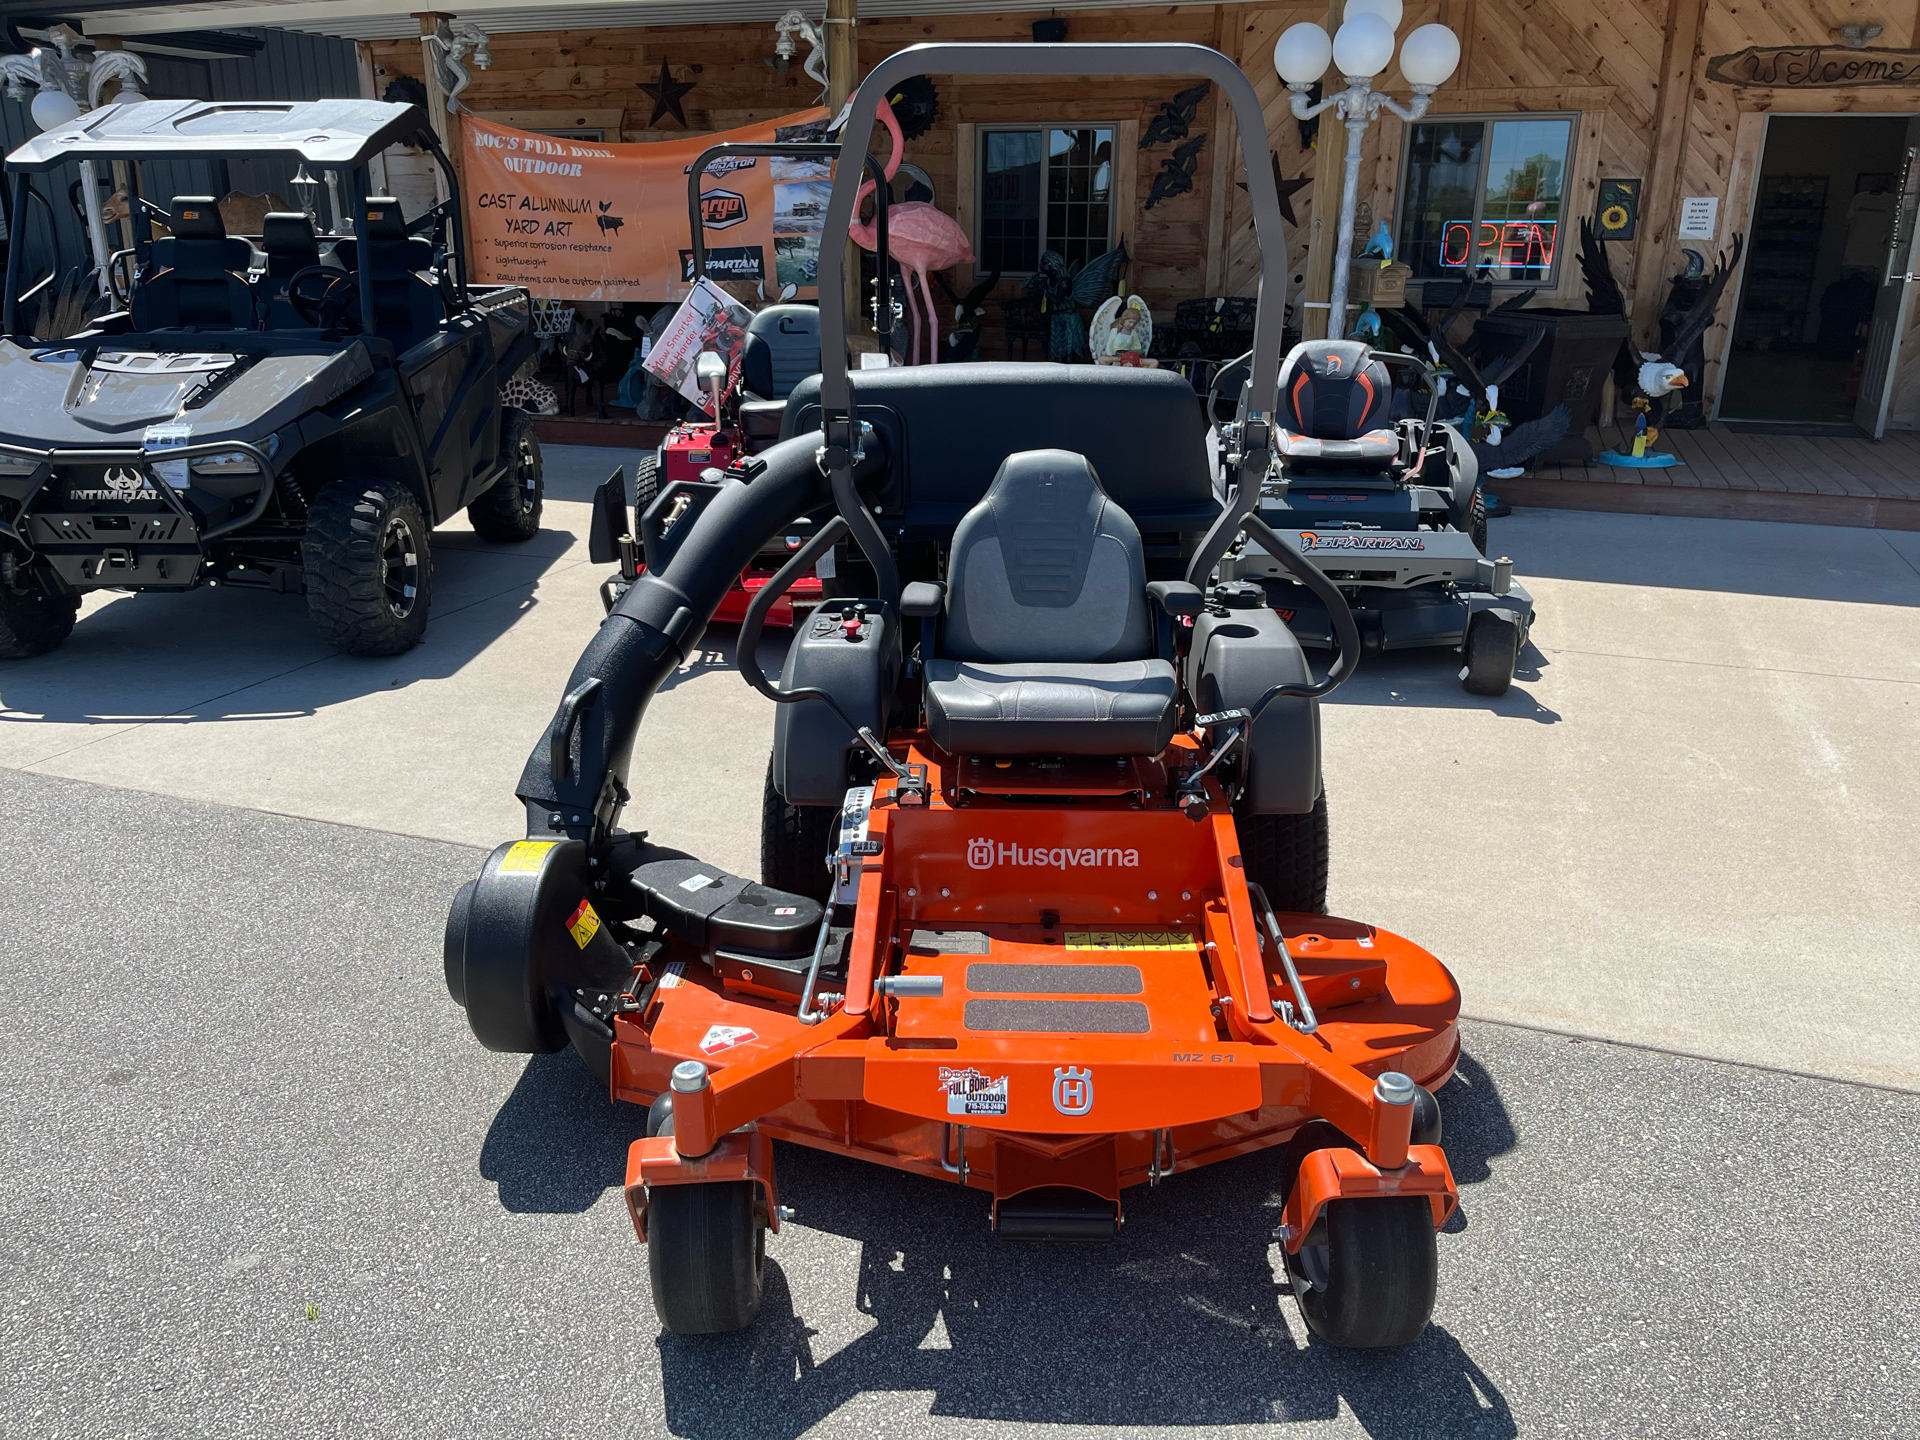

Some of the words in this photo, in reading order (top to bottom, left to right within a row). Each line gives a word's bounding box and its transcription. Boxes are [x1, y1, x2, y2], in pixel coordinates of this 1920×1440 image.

[1743, 49, 1920, 85] Welcome
[474, 131, 519, 150] DOC'S
[524, 138, 567, 156] FULL
[504, 157, 583, 177] OUTDOOR
[478, 193, 516, 209] CAST
[519, 196, 593, 214] ALUMINUM
[505, 218, 540, 235] YARD
[544, 221, 573, 237] ART
[494, 238, 528, 250] Superior
[530, 241, 567, 251] corrosion
[569, 243, 612, 252] resistance
[1444, 224, 1557, 265] OPEN
[496, 256, 547, 269] Lightweight
[704, 259, 759, 271] SPARTAN
[497, 273, 516, 282] Raw
[518, 273, 541, 284] items
[559, 275, 571, 285] be
[572, 276, 602, 286] custom
[604, 278, 641, 290] painted
[652, 349, 671, 372] Mow
[667, 312, 695, 349] Smarter
[661, 359, 677, 380] Not
[675, 329, 698, 359] Harder
[70, 489, 184, 501] INTIMIDATR
[1315, 536, 1422, 549] SPARTAN
[998, 842, 1139, 870] Husqvarna
[1173, 1053, 1204, 1062] MZ
[1211, 1054, 1235, 1063] 61
[939, 1067, 979, 1079] Doc's
[949, 1080, 967, 1095] FULL
[969, 1078, 990, 1092] BORE
[966, 1093, 1006, 1102] OUTDOOR
